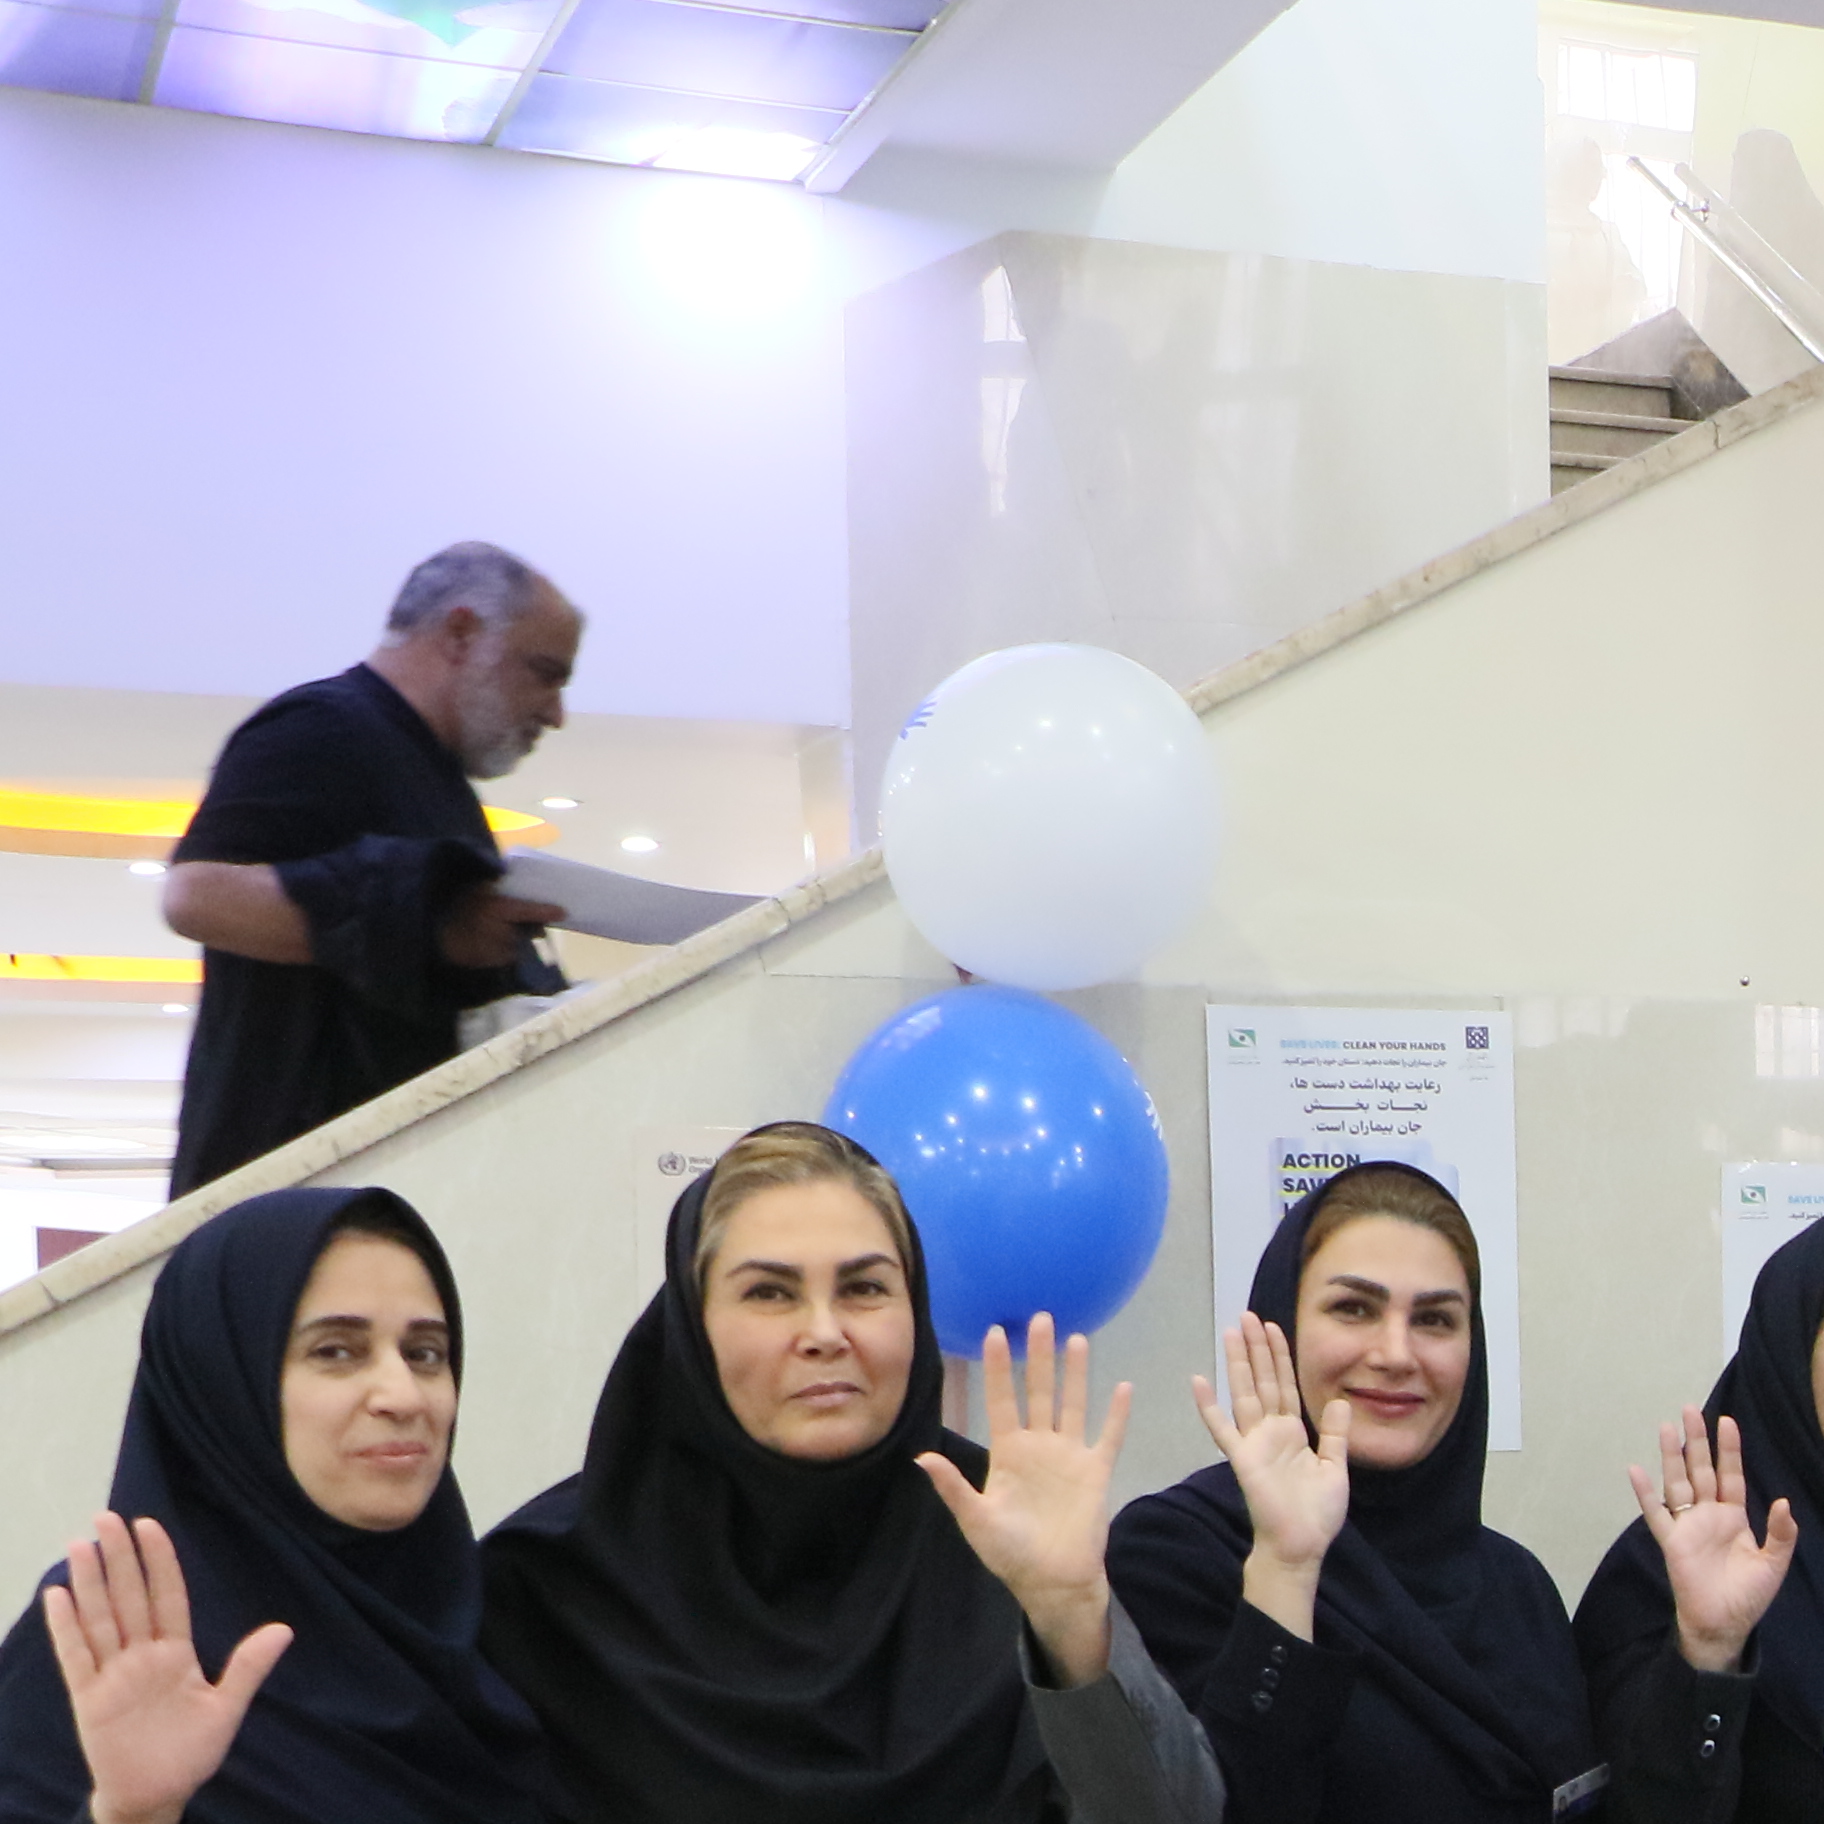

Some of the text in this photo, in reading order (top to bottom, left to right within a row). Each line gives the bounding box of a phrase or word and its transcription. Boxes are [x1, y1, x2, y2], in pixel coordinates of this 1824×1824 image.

[1343, 1041, 1376, 1050] CLEAN
[1379, 1041, 1407, 1050] YOUR
[1409, 1041, 1446, 1051] HANDS
[1313, 1078, 1345, 1090] دست
[1350, 1077, 1400, 1093] بهداشت
[1405, 1078, 1441, 1094] رعایت
[1350, 1120, 1393, 1136] بیماران
[1398, 1121, 1422, 1135] جان
[1282, 1153, 1360, 1169] ACTION
